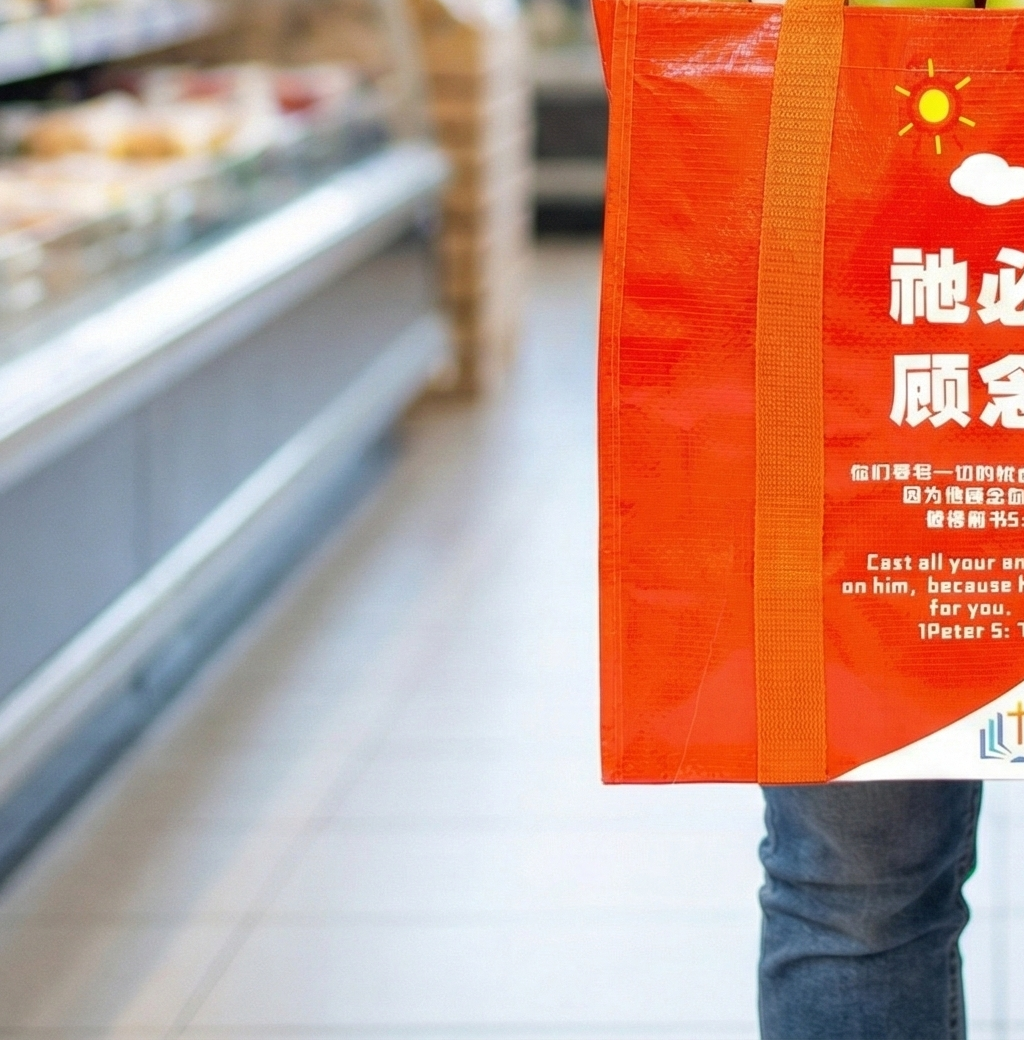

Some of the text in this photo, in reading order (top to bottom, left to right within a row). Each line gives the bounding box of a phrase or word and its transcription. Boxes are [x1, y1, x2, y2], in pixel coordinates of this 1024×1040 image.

[918, 553, 943, 571] all
[949, 558, 996, 574] your
[842, 581, 867, 594] on
[873, 576, 916, 597] him,
[927, 576, 1012, 594] because
[929, 598, 1012, 620] for you.
[918, 622, 985, 640] 1Peter
[991, 622, 1010, 640] 5:
